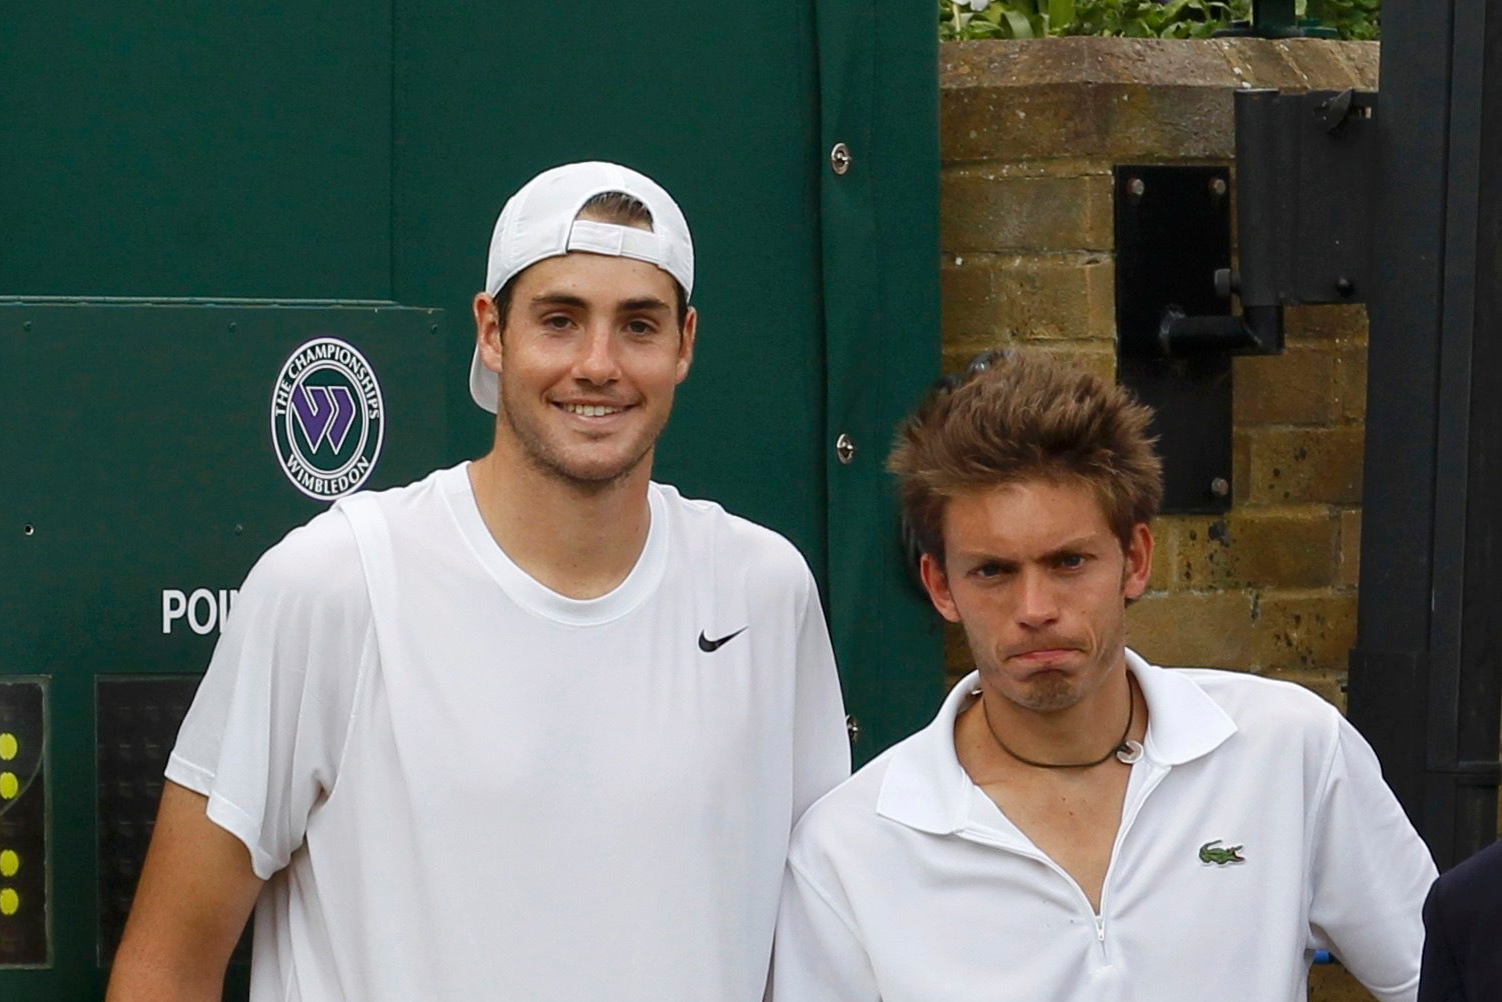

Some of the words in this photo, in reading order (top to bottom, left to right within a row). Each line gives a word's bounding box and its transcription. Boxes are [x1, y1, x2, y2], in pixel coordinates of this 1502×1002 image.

[275, 380, 292, 417] THE
[288, 344, 380, 420] CHAMPIONSHIPS
[286, 453, 371, 495] WIMBLEDON
[162, 588, 239, 635] POI
